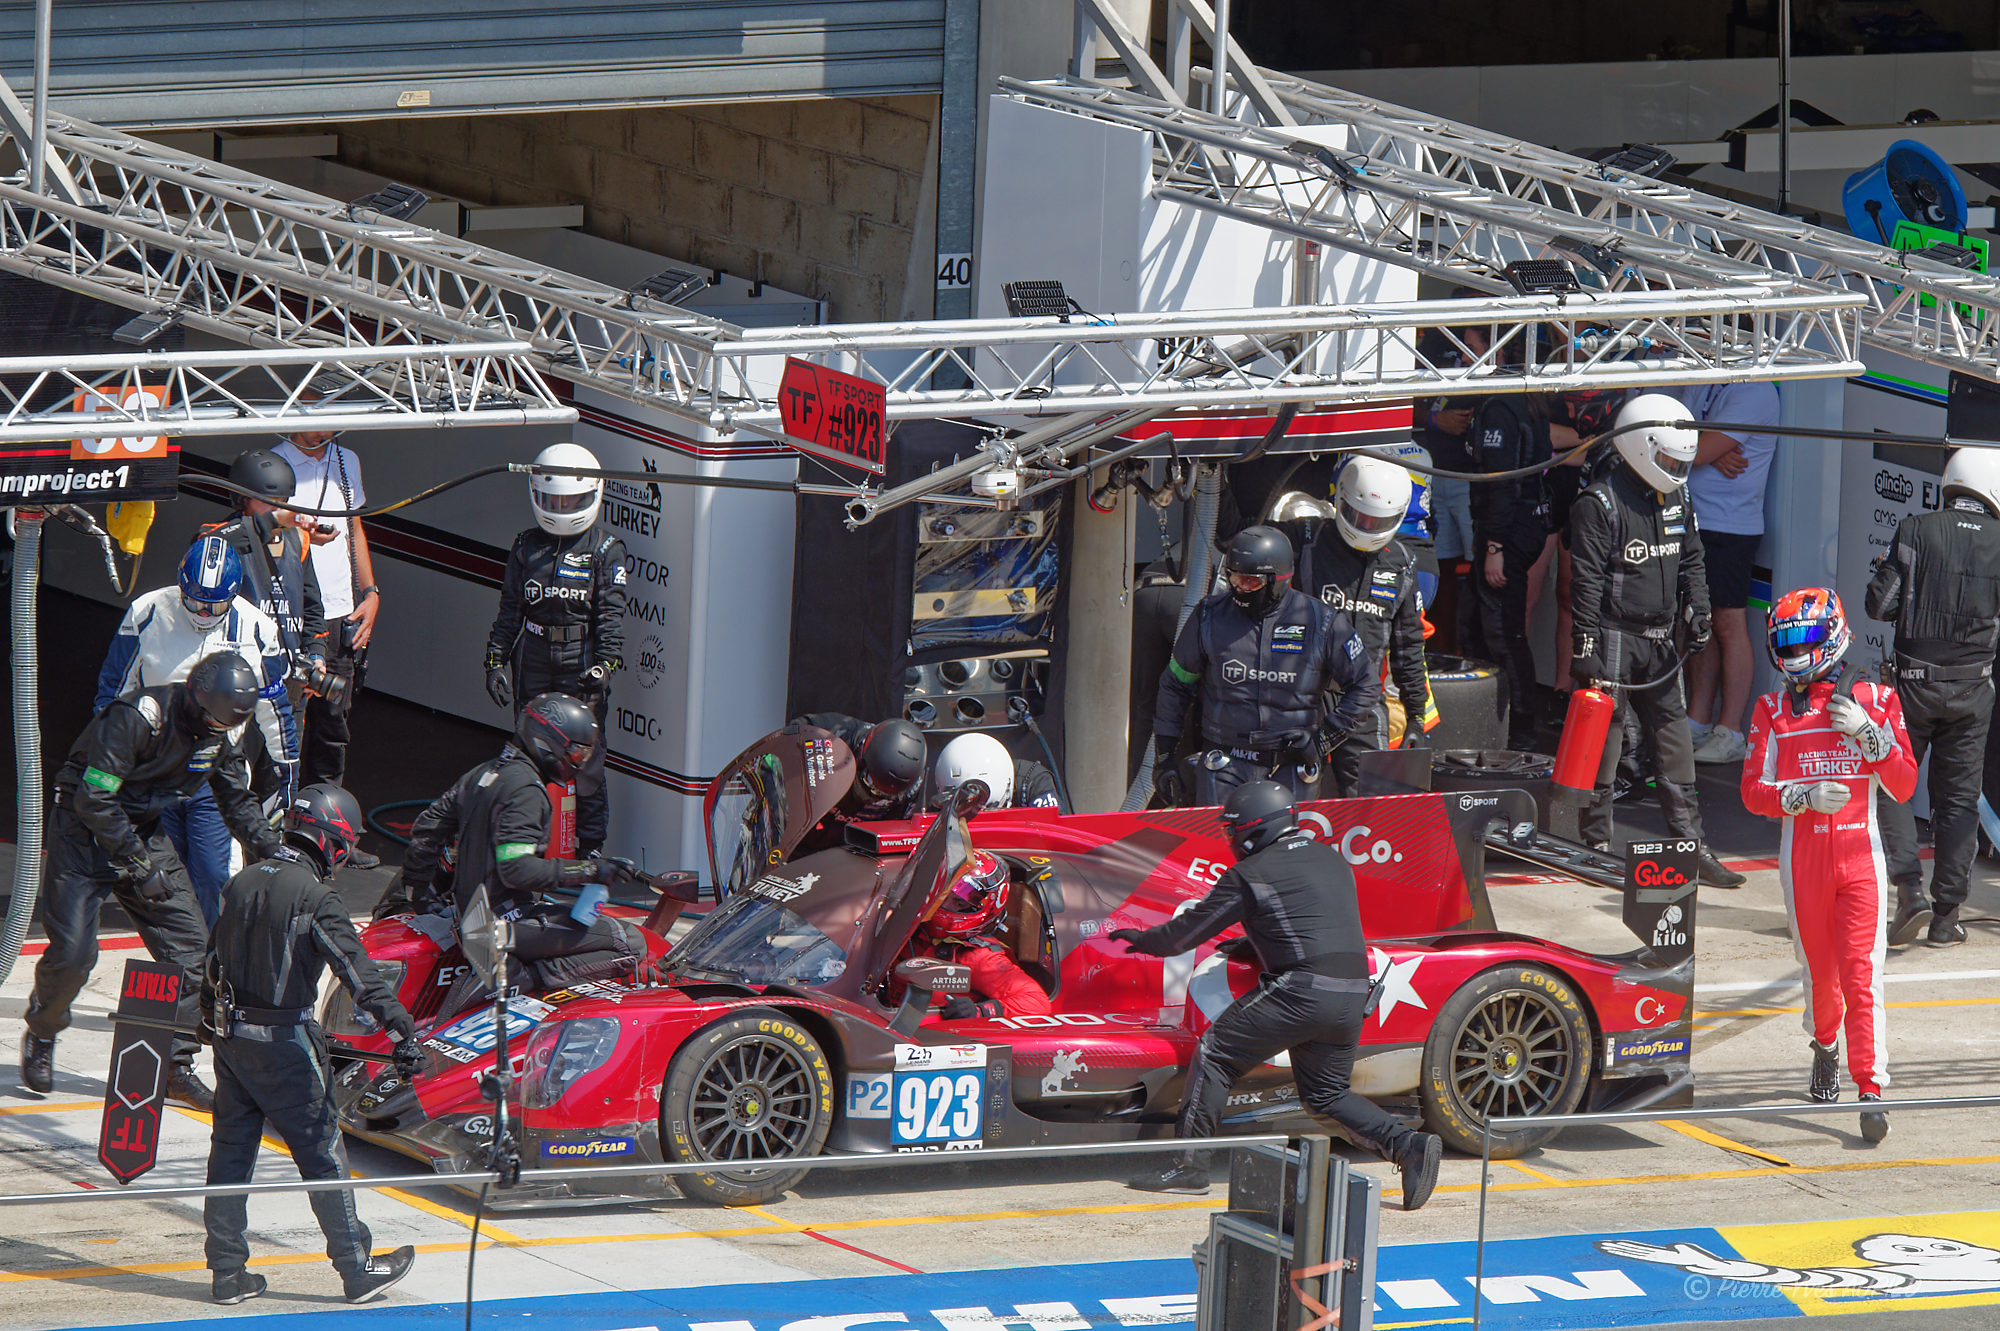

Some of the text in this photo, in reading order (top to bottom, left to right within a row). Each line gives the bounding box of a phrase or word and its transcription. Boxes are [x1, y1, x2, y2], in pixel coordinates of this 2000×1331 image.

[938, 257, 972, 285] 40
[827, 379, 881, 410] TF SPORT
[787, 386, 816, 425] TF
[828, 403, 881, 464] #923
[0, 465, 130, 498] mproject1
[1875, 470, 1914, 499] glinche
[628, 486, 650, 503] TEAM
[602, 499, 661, 539] TURKEY
[1874, 509, 1897, 527] CMG
[1627, 546, 1645, 558] TF
[626, 554, 670, 587] OTOR
[526, 586, 588, 601] TF SPORT
[1326, 590, 1386, 617] TF SPORT
[1792, 619, 1817, 628] TURKEY
[1225, 667, 1297, 684] TF SPORT
[1798, 750, 1828, 760] RACING
[1800, 761, 1862, 777] TURKEY
[1462, 797, 1499, 808] TF SPORT
[1632, 843, 1663, 855] 1923
[499, 907, 524, 925] RTC
[1652, 929, 1687, 947] kito
[124, 970, 179, 1003] START
[988, 1013, 1106, 1030] 100
[422, 1038, 475, 1063] PRO AM
[907, 1047, 932, 1060] 24h
[1620, 1040, 1684, 1058] GOODYEAR
[759, 1019, 832, 1113] GOODYEAR
[850, 1080, 889, 1111] P2
[1226, 1091, 1264, 1107] HRX
[897, 1074, 981, 1141] 923
[110, 1117, 147, 1152] TF
[548, 1140, 627, 1157] GOODYEAR
